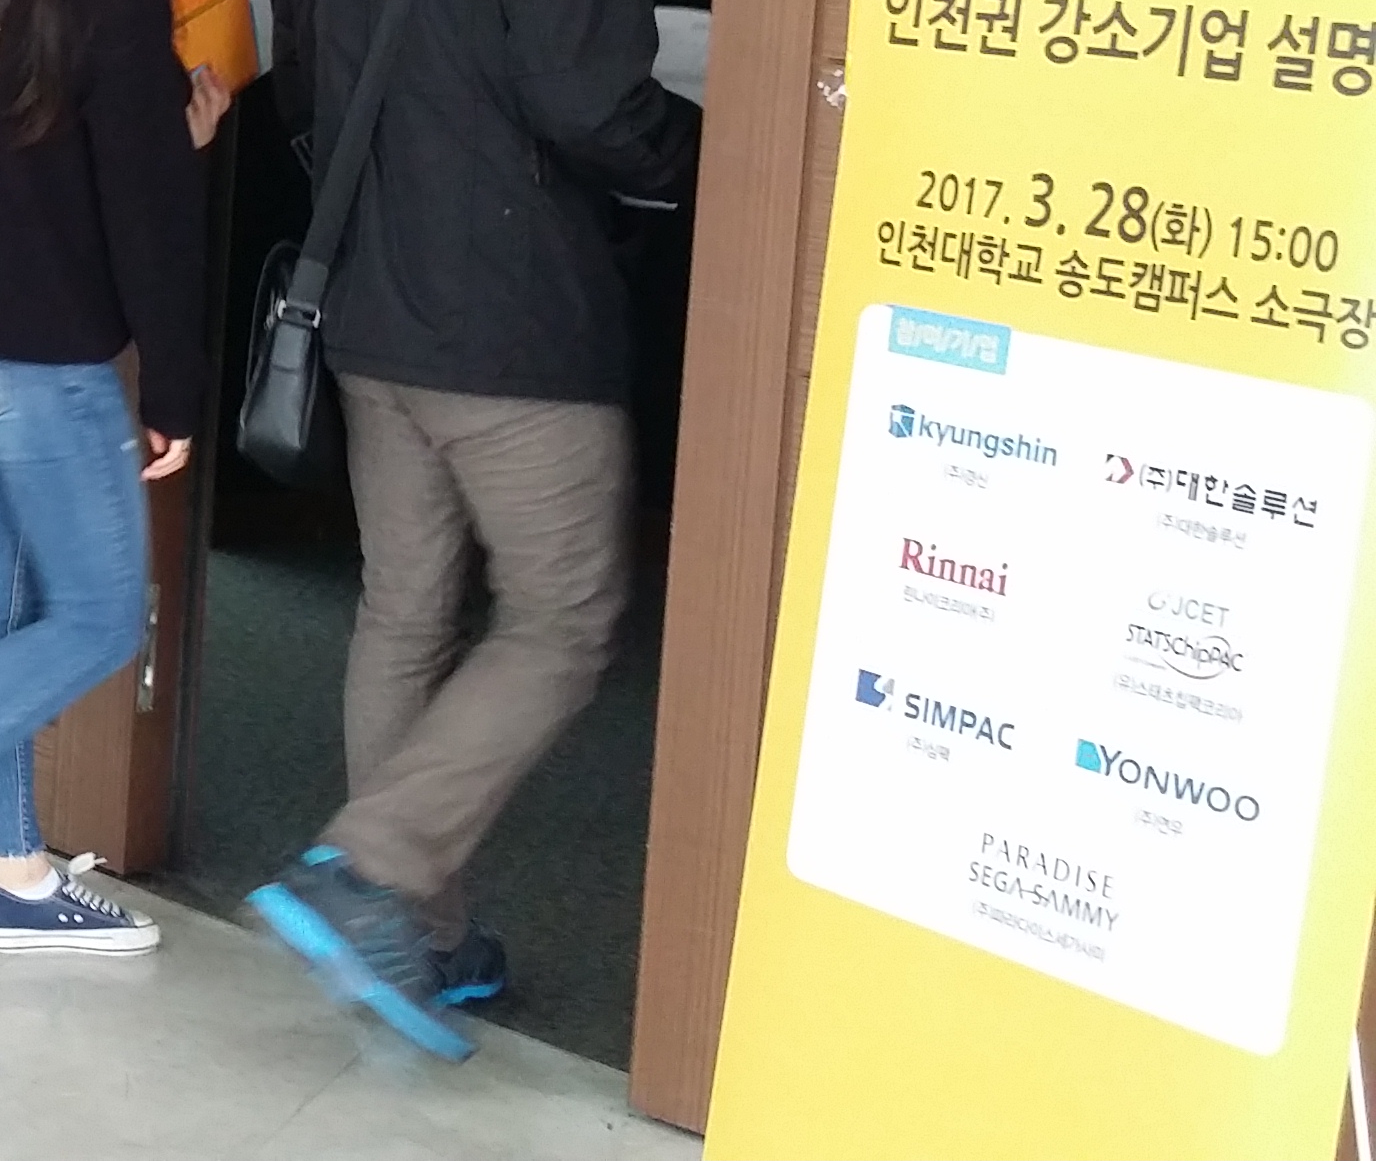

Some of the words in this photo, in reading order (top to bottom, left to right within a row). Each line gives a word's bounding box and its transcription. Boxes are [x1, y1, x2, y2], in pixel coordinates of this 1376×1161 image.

[916, 170, 1011, 226] 2017.
[1024, 172, 1067, 236] 3.
[1085, 181, 1213, 259] 28(화)
[1230, 217, 1339, 273] 15:00
[877, 219, 1044, 287] 인천대학교
[1055, 248, 1239, 320] 송도캠퍼스
[1250, 284, 1376, 350] 소극장
[919, 414, 1059, 467] kyungshin
[1139, 463, 1318, 529] (주)대한솔루션
[899, 536, 1010, 597] Rinnai
[1171, 596, 1231, 628] JCET
[904, 693, 1016, 751] SIMPAC
[1099, 744, 1261, 822] YONWOO
[981, 832, 1116, 899] PARADISE
